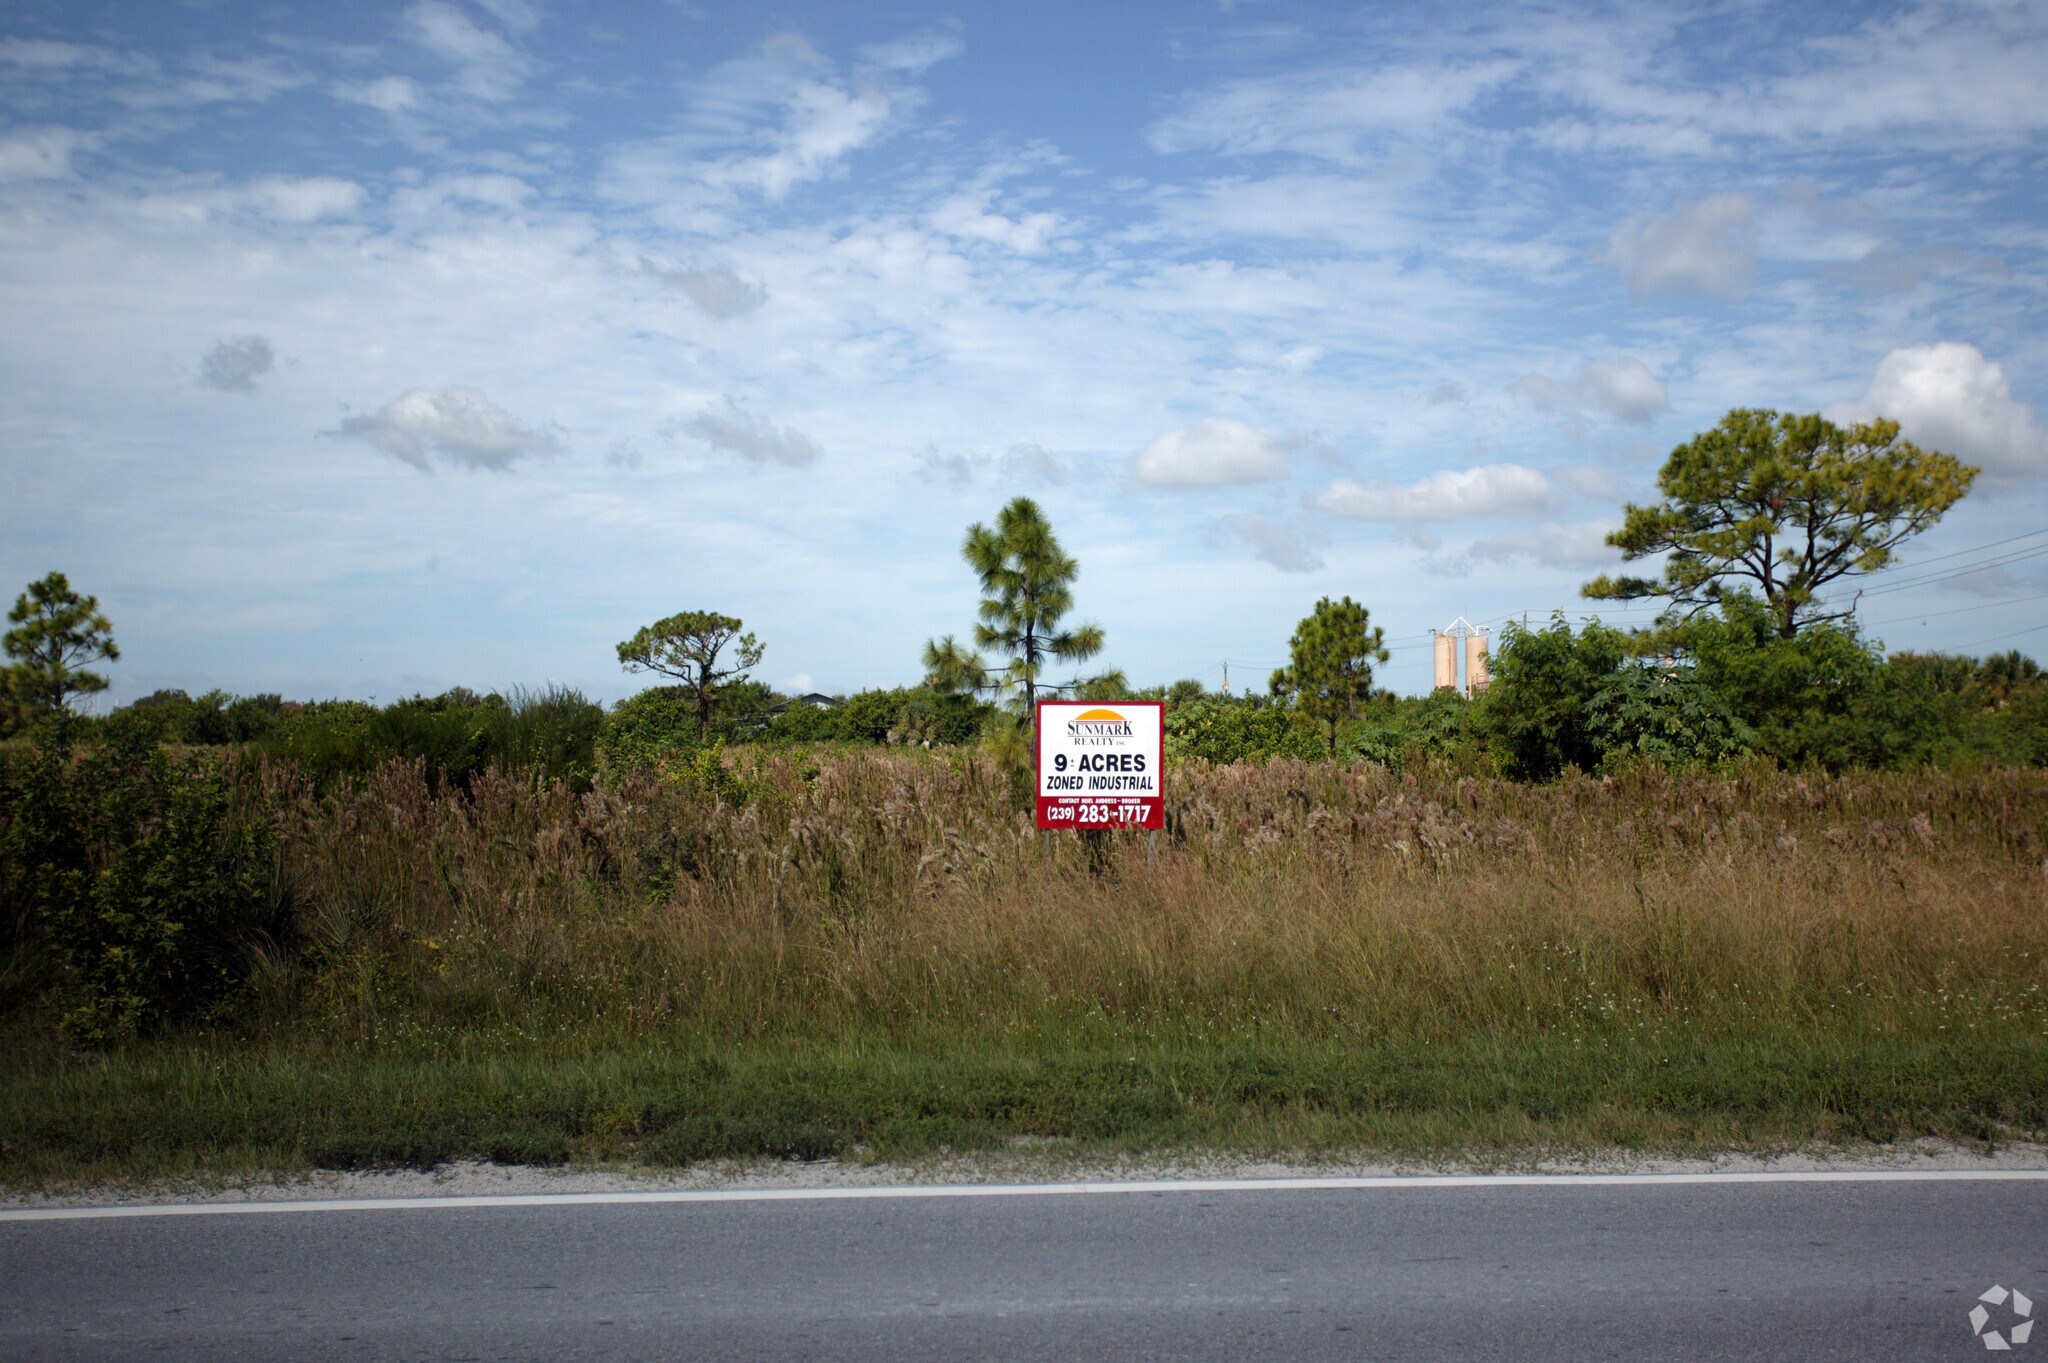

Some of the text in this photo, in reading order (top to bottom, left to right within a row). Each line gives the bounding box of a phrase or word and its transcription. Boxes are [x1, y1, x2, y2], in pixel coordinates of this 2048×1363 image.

[1067, 720, 1133, 736] SUNMARK
[1074, 737, 1115, 746] REALTY
[1054, 753, 1068, 772] 9
[1078, 753, 1146, 772] ACRES
[1046, 776, 1153, 790] ZONED INDUSTRIAL
[1047, 804, 1152, 823] (239) 283-1717
